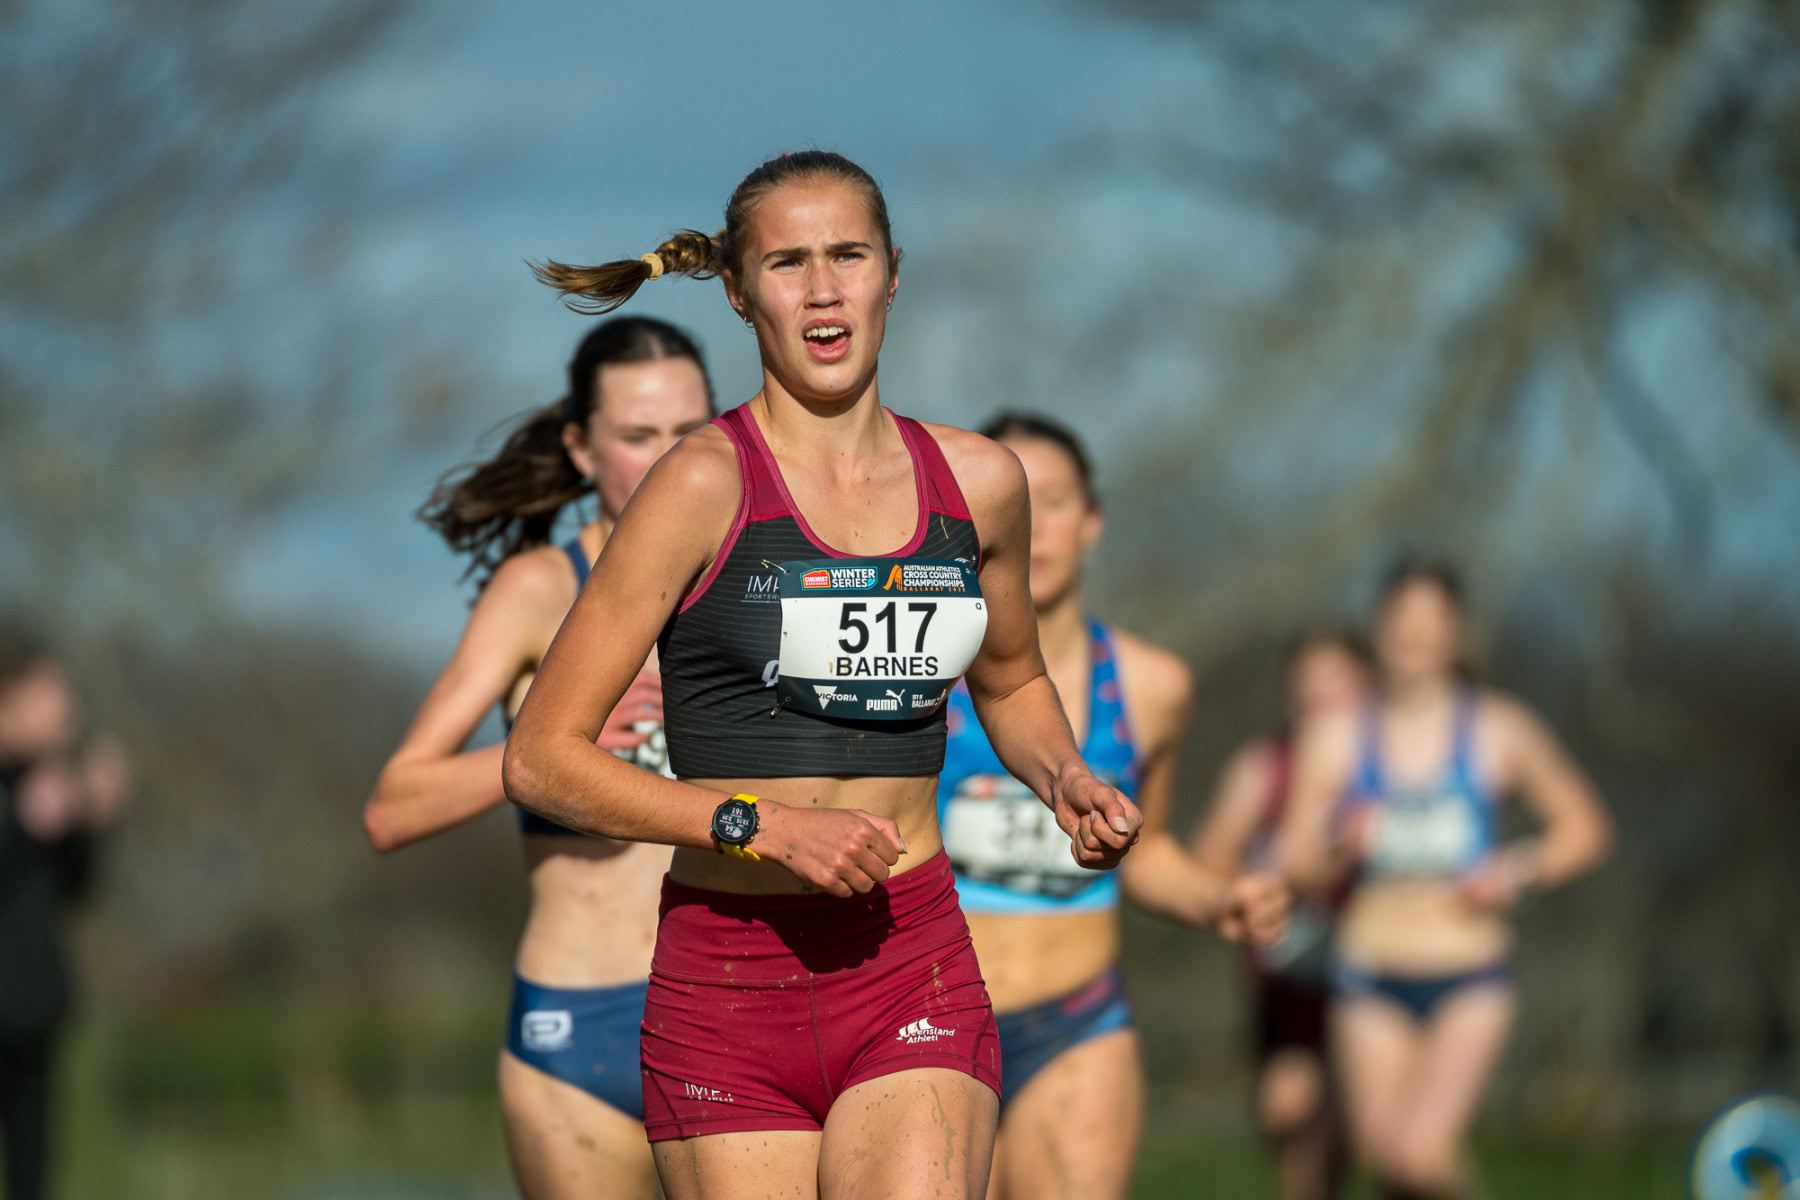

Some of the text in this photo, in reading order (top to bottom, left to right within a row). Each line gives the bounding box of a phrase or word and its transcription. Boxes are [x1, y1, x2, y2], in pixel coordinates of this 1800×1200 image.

[903, 564, 936, 572] AUSTRALIAN
[830, 568, 876, 579] WINTER
[903, 571, 962, 580] CROSS COUNTRY
[832, 578, 868, 588] SERIES
[903, 579, 965, 588] CHAMPIONSHIPS
[838, 601, 938, 654] 517
[835, 656, 939, 677] BARNES
[818, 693, 858, 702] VICTORIA
[866, 699, 898, 711] PUMA
